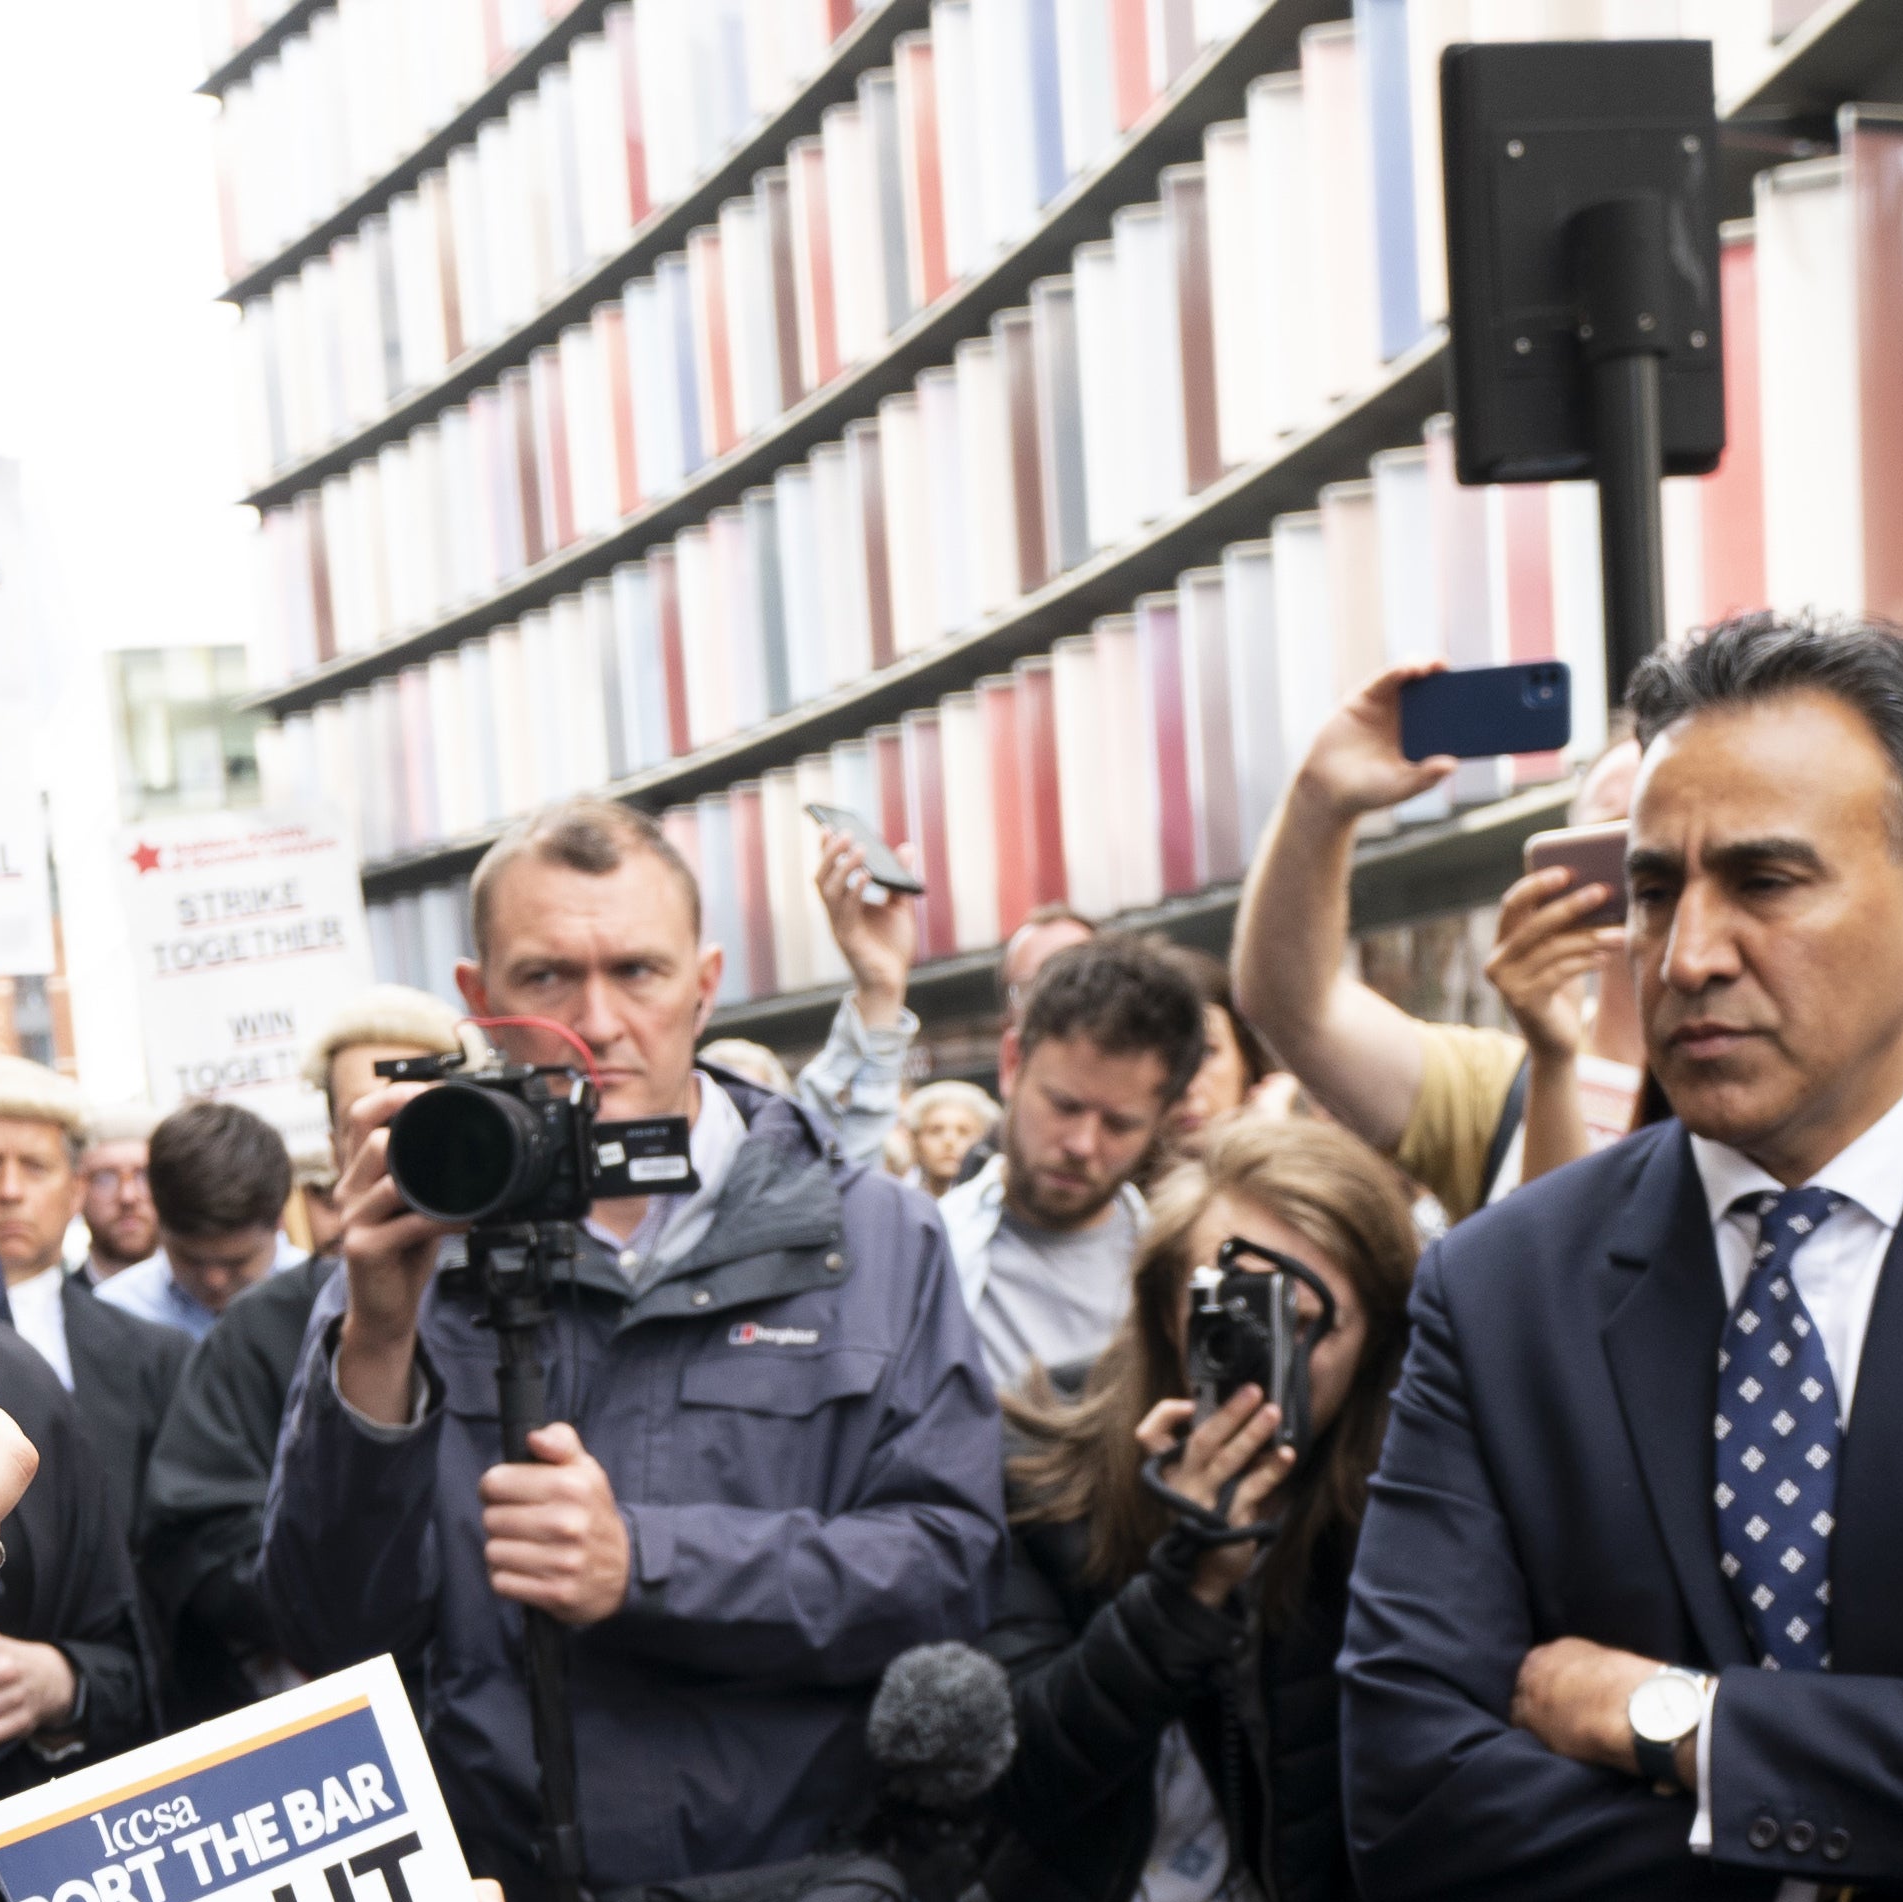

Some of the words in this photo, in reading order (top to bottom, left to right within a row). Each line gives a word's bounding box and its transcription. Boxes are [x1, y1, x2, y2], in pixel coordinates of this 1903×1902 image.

[175, 878, 306, 927] STRIKE
[153, 914, 345, 975] TOGETHER
[227, 1009, 296, 1042] WIN
[175, 1050, 298, 1095] TOGET
[89, 1795, 201, 1858] lccsa
[171, 1801, 290, 1886] THE
[282, 1762, 395, 1846] BAR
